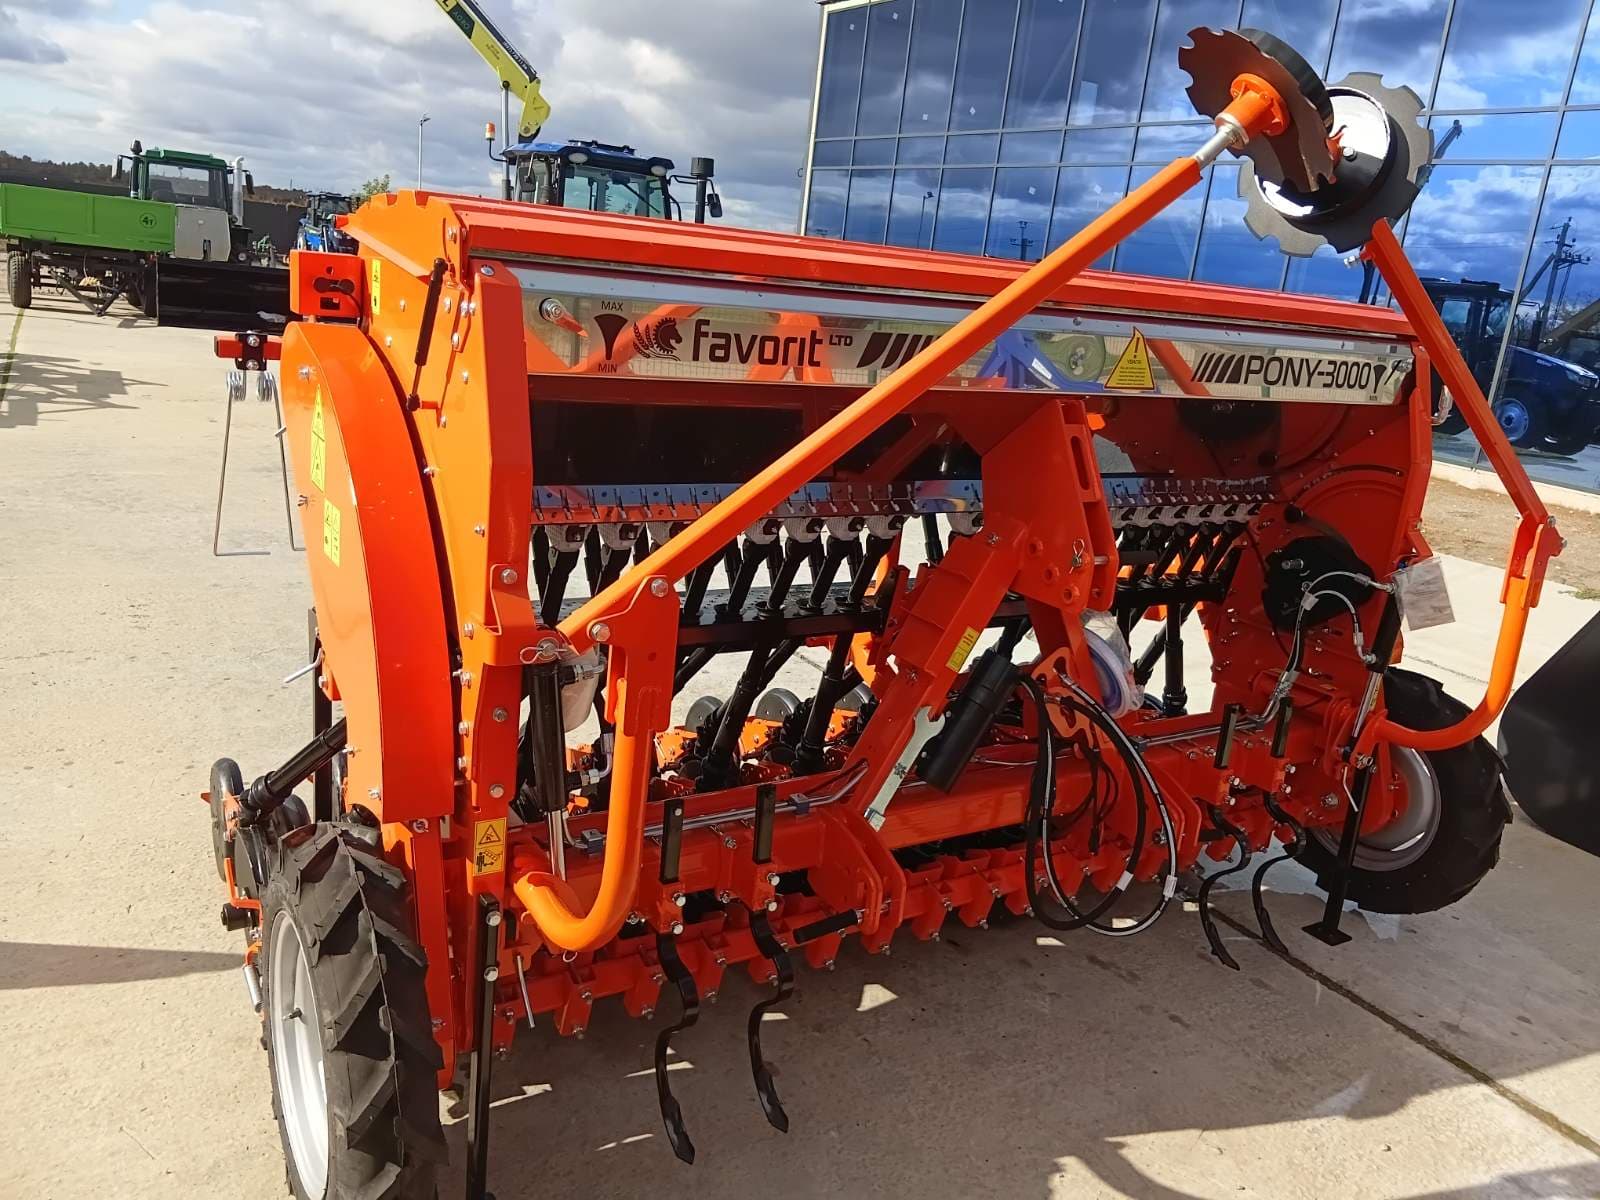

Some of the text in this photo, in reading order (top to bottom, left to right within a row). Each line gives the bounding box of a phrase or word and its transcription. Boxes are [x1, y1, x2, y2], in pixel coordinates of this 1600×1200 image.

[600, 300, 624, 312] MAX
[692, 318, 853, 367] favorit LTD
[598, 362, 618, 374] MIN
[1243, 355, 1372, 389] PONY-3000
